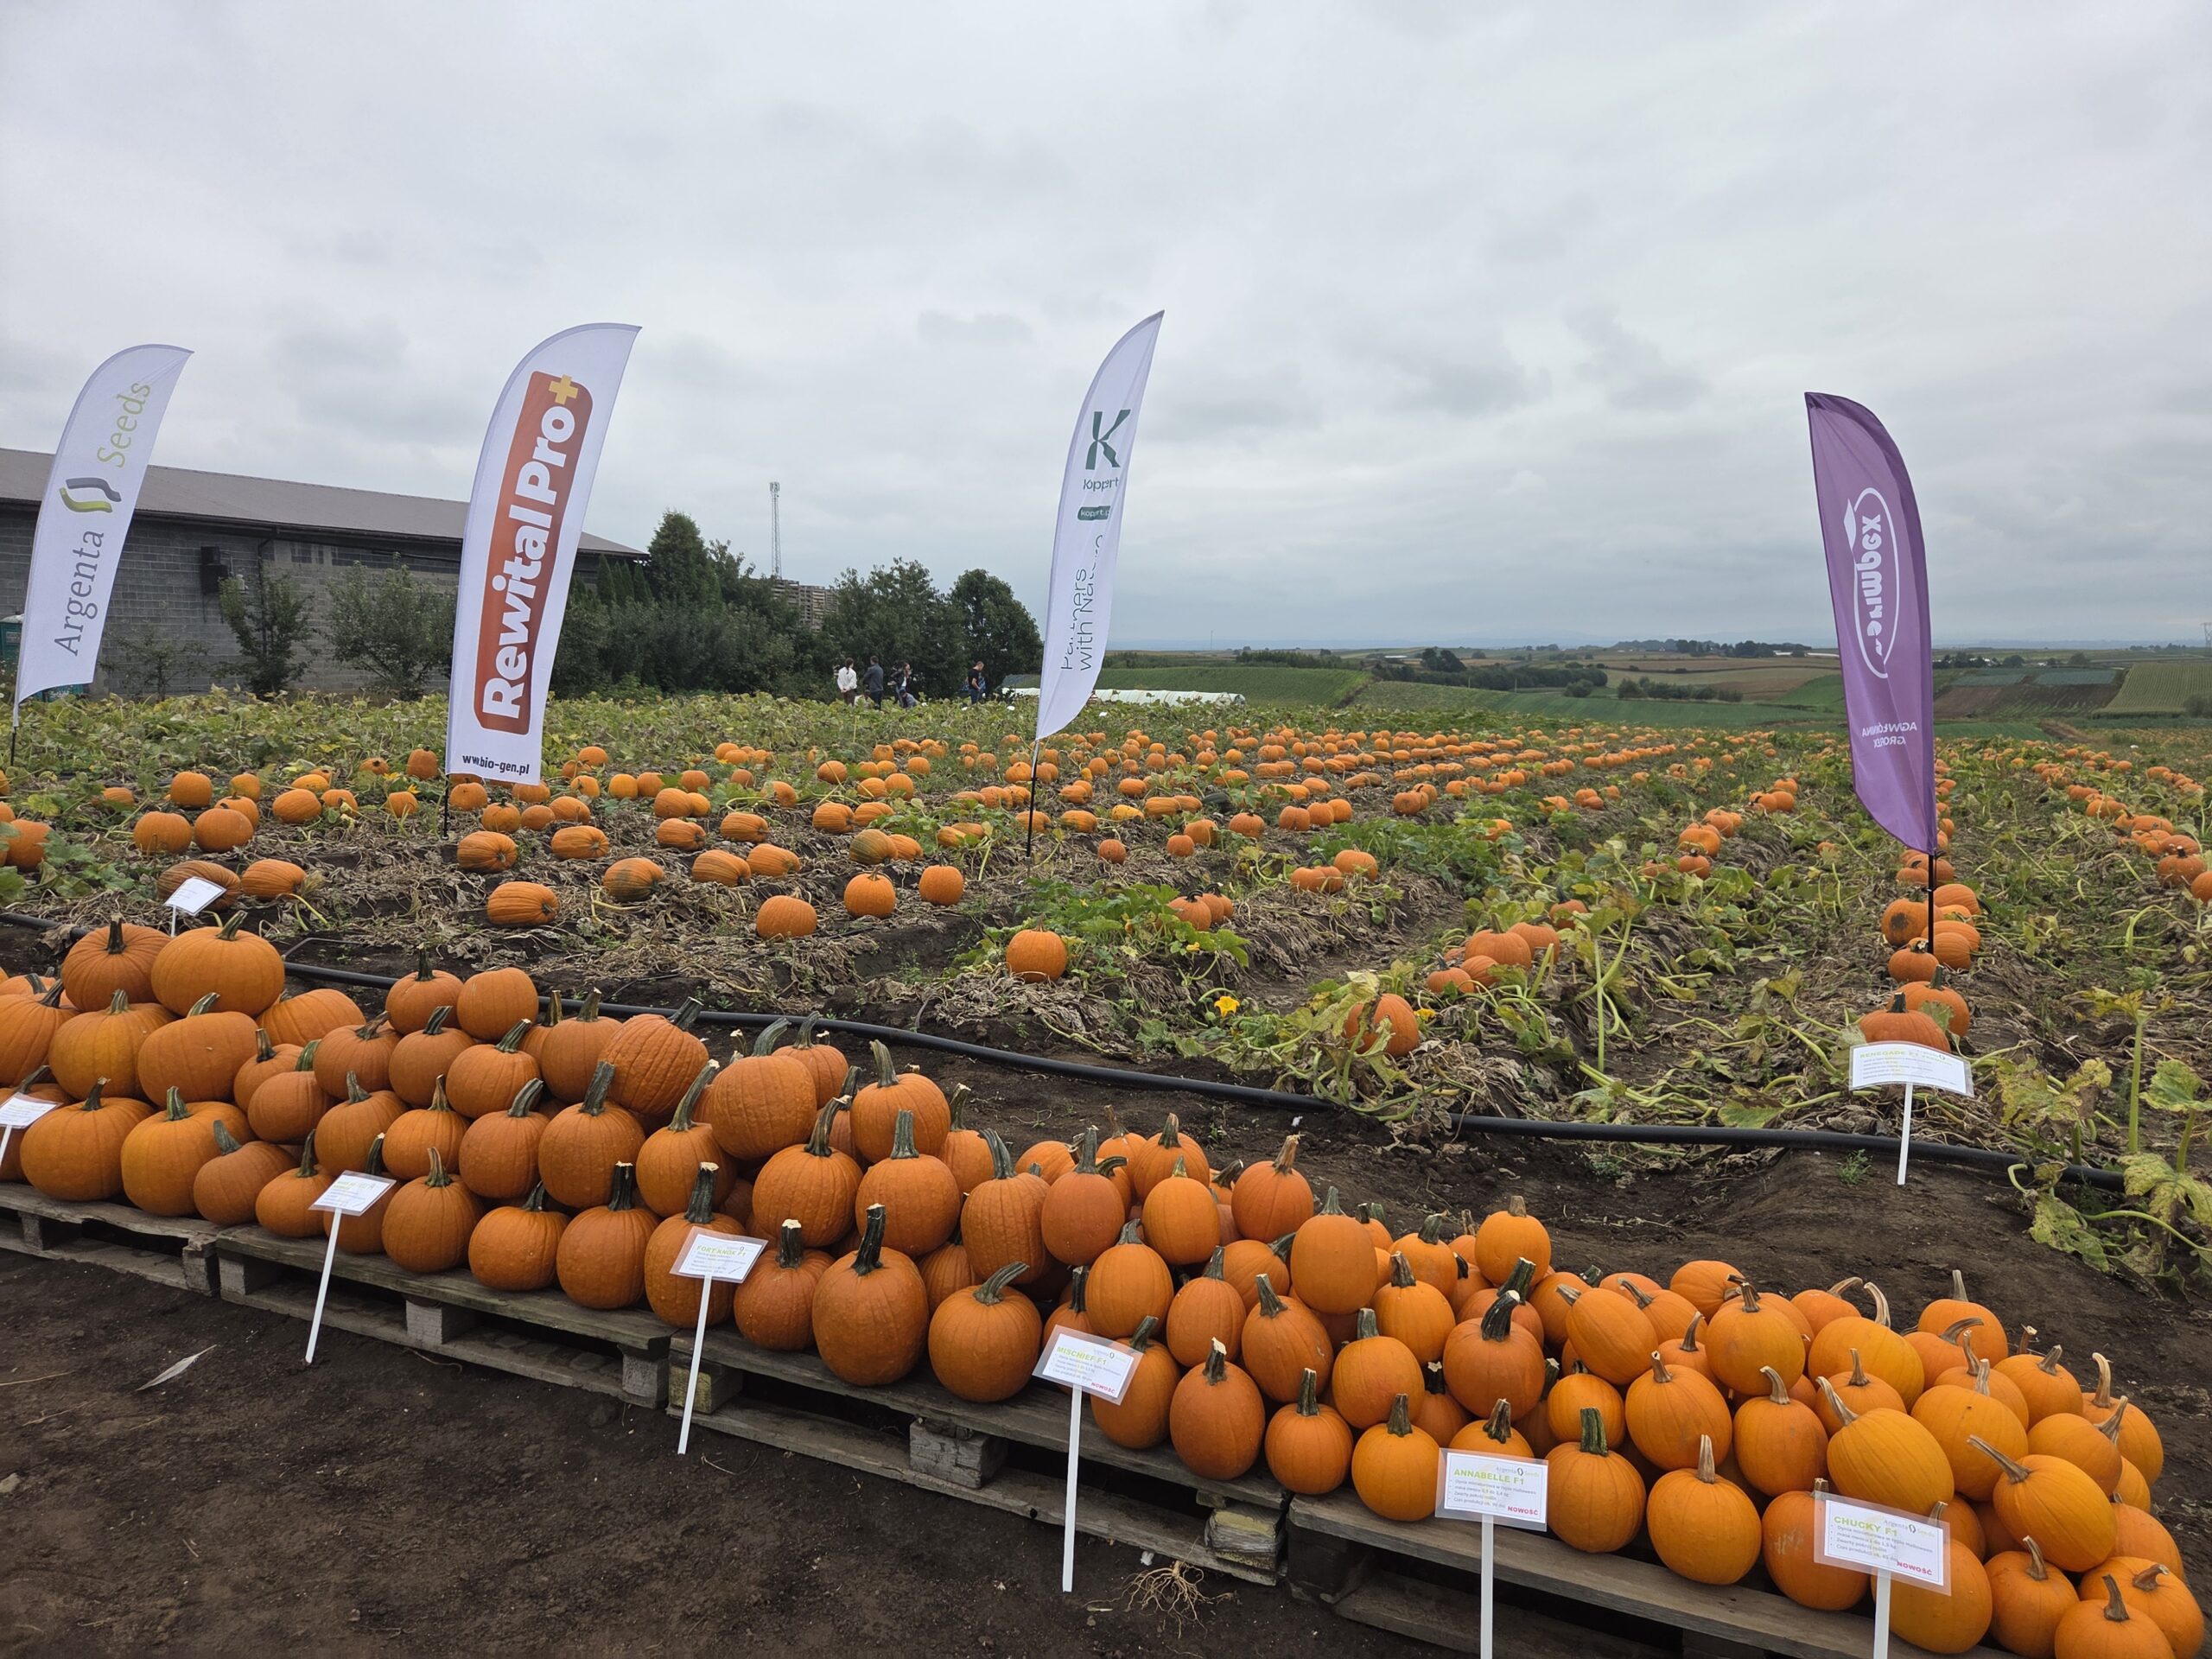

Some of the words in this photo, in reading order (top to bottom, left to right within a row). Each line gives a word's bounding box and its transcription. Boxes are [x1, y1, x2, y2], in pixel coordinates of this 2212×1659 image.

[54, 529, 105, 657] Argenta
[96, 381, 152, 468] Seeds
[1077, 621, 1093, 671] with
[1860, 1050, 1907, 1058] RENEGADE
[1057, 1346, 1096, 1361] MISCHIEF
[1453, 1468, 1510, 1483] ANNABELLE
[1514, 1477, 1524, 1485] F1
[1834, 1516, 1881, 1533] CHUCKY
[1885, 1528, 1897, 1537] F1
